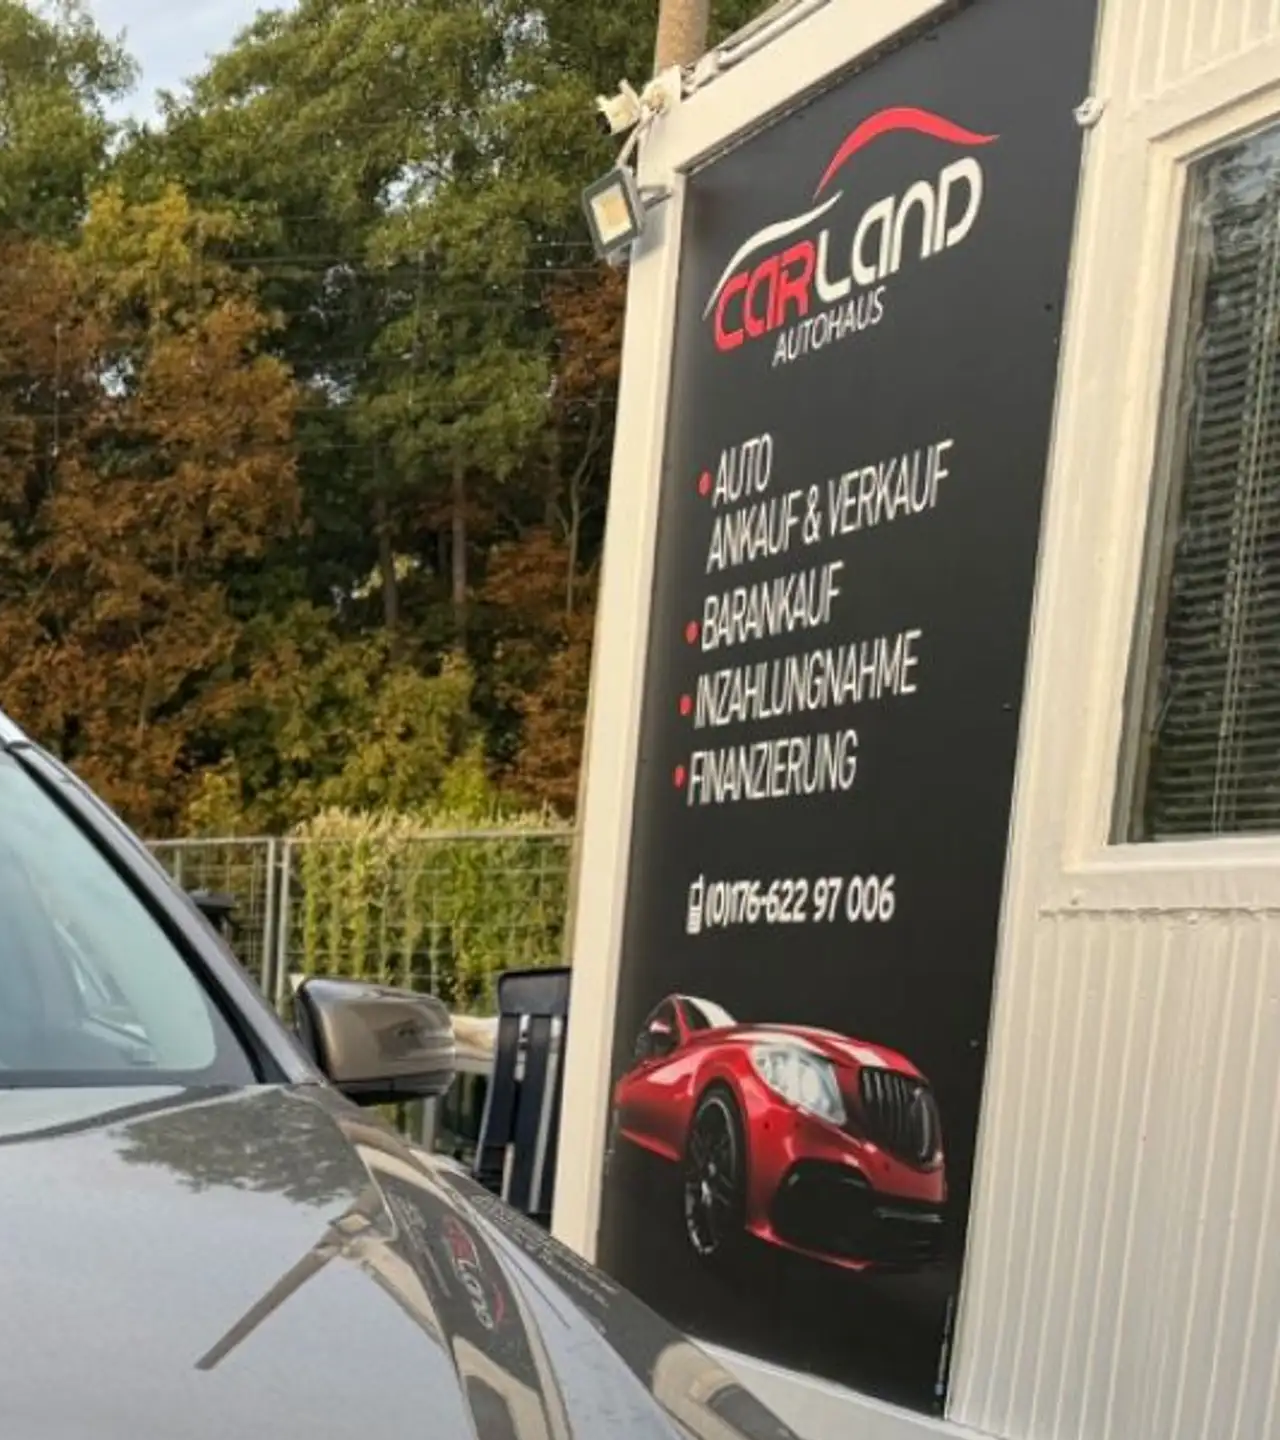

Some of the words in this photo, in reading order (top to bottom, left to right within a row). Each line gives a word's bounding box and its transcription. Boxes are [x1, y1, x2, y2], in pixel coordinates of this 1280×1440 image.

[714, 157, 984, 352] CARLAND
[772, 285, 885, 367] AUTOHAUS
[706, 488, 802, 574] ANKAUF
[802, 485, 820, 545] &
[826, 439, 954, 538] VERKAUF
[712, 433, 773, 508] AUTO
[701, 561, 844, 652] BARANKAUF
[694, 629, 922, 728] INZAHLUNGNAHME
[687, 729, 859, 806] FINANZIERUNG
[813, 877, 844, 922] 97
[846, 874, 896, 922] 006
